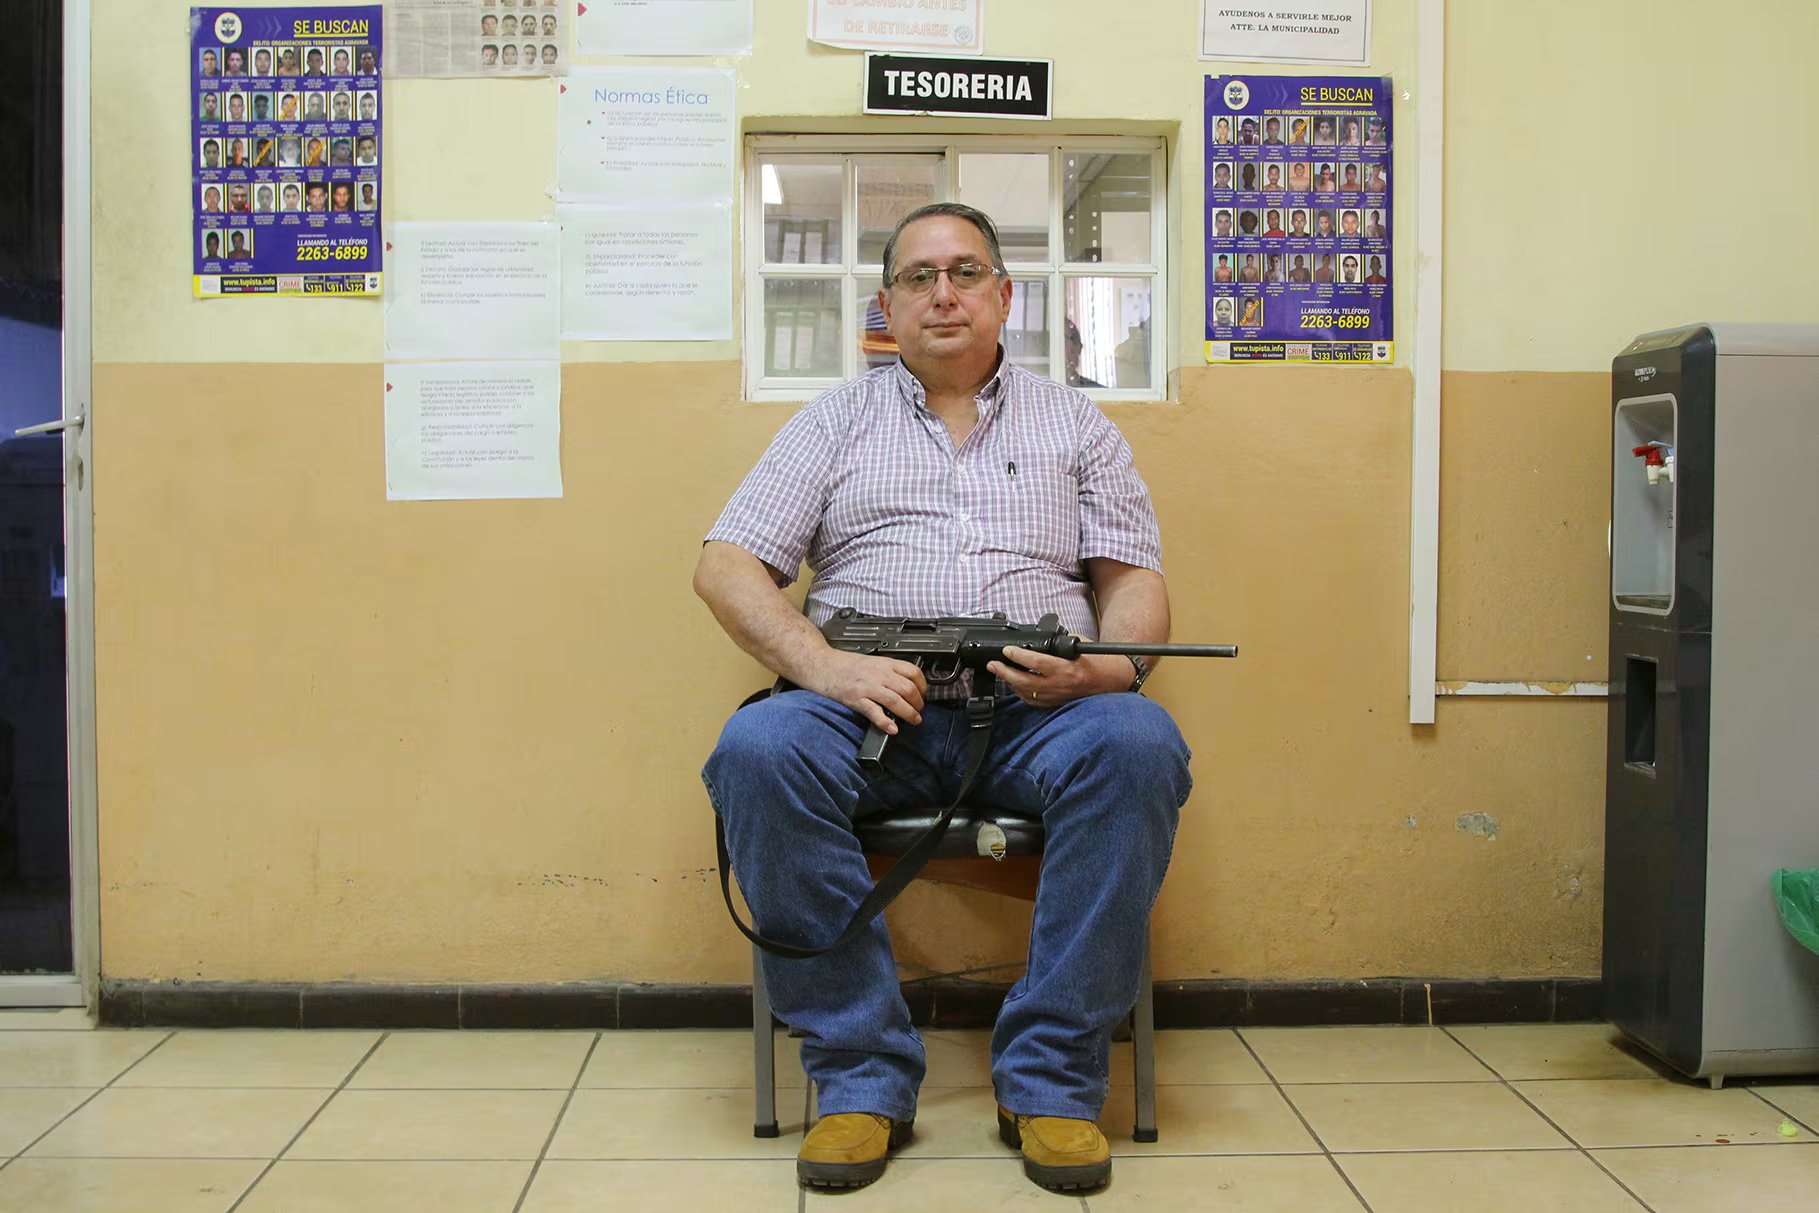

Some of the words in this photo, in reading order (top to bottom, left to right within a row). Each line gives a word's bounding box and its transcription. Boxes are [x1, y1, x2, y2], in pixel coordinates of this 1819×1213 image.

[1219, 10, 1266, 19] AYUDENOS
[1276, 12, 1319, 21] SERVIRLE
[1322, 14, 1352, 22] MEJOR
[294, 19, 310, 34] SE
[314, 19, 369, 34] BUSCAN
[843, 20, 864, 33] DE
[868, 20, 949, 37] RETIRARSE
[1230, 23, 1256, 31] ATTE.
[1259, 24, 1269, 32] LA
[1272, 25, 1340, 35] MUNICIPALIDAD
[884, 70, 1033, 101] TESORERIA
[595, 88, 661, 104] Normas
[666, 86, 709, 105] Ética
[1301, 87, 1317, 101] SE
[1320, 87, 1373, 101] BUSCAN
[339, 237, 368, 246] TELÉFONO
[297, 246, 368, 261] 2263-6899
[1342, 306, 1370, 315] TELÉFONO
[1300, 315, 1370, 328] 2263-6899
[1233, 345, 1284, 353] www.tupista.info
[1319, 352, 1330, 360] 133
[1339, 352, 1350, 360] 911
[1359, 352, 1371, 360] 122
